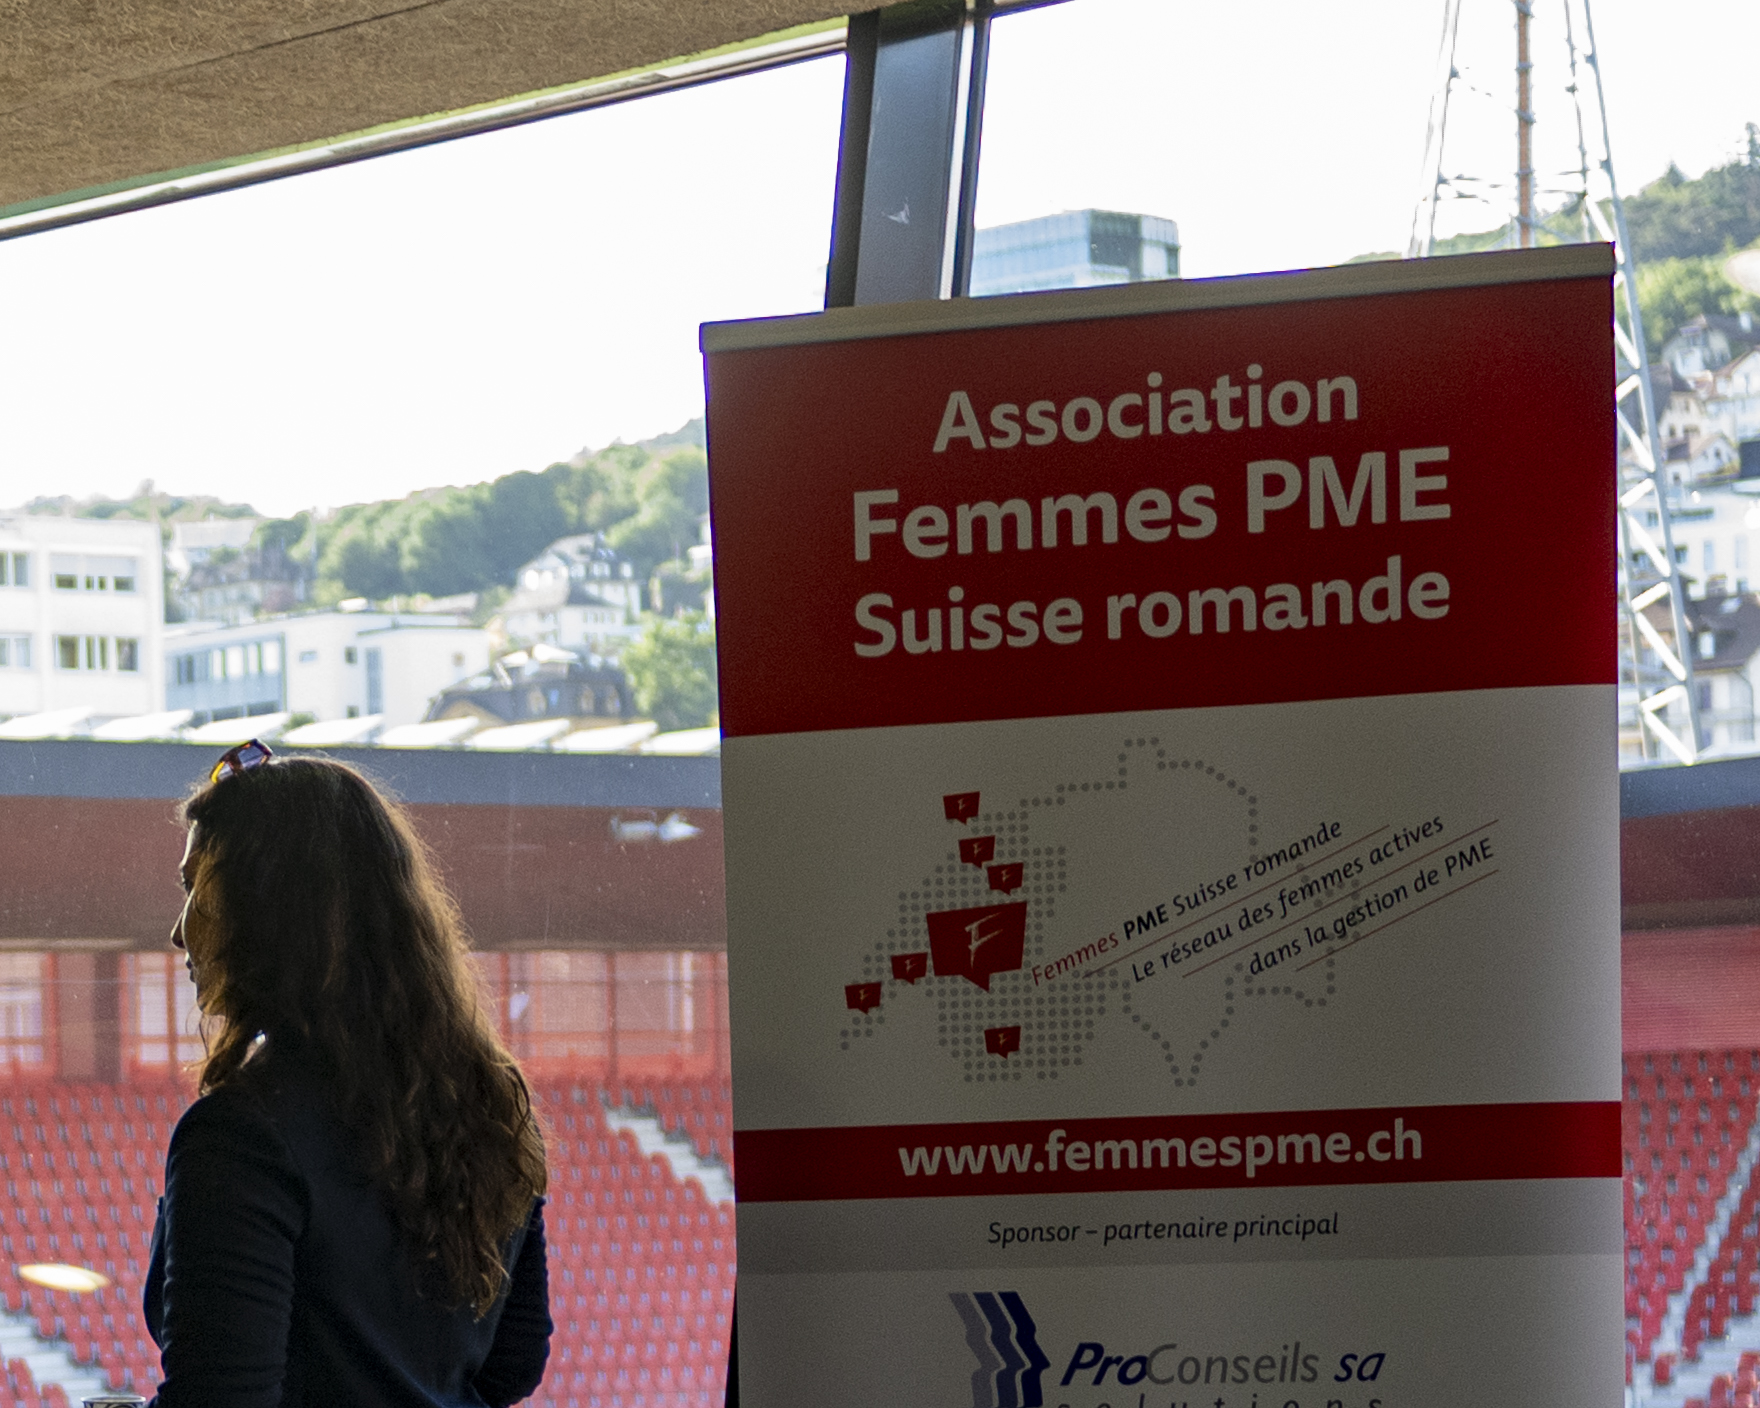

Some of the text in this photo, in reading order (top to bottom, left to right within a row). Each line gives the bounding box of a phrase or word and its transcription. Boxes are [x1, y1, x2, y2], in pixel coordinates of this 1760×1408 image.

[934, 365, 1360, 452] Association
[853, 447, 1452, 561] Femmes PME
[854, 556, 1451, 659] Suisse romande
[1032, 822, 1342, 986] Femmes PME Suisse romande
[1132, 816, 1443, 982] Le réseau des femmes actives
[1250, 838, 1494, 975] dans la gestion de PME
[898, 1118, 1422, 1178] www.femmespme.ch
[988, 1220, 1080, 1249] Sponsor
[1104, 1217, 1227, 1245] partenaire
[1234, 1213, 1339, 1242] principal
[1060, 1342, 1386, 1386] ProConseils sa
